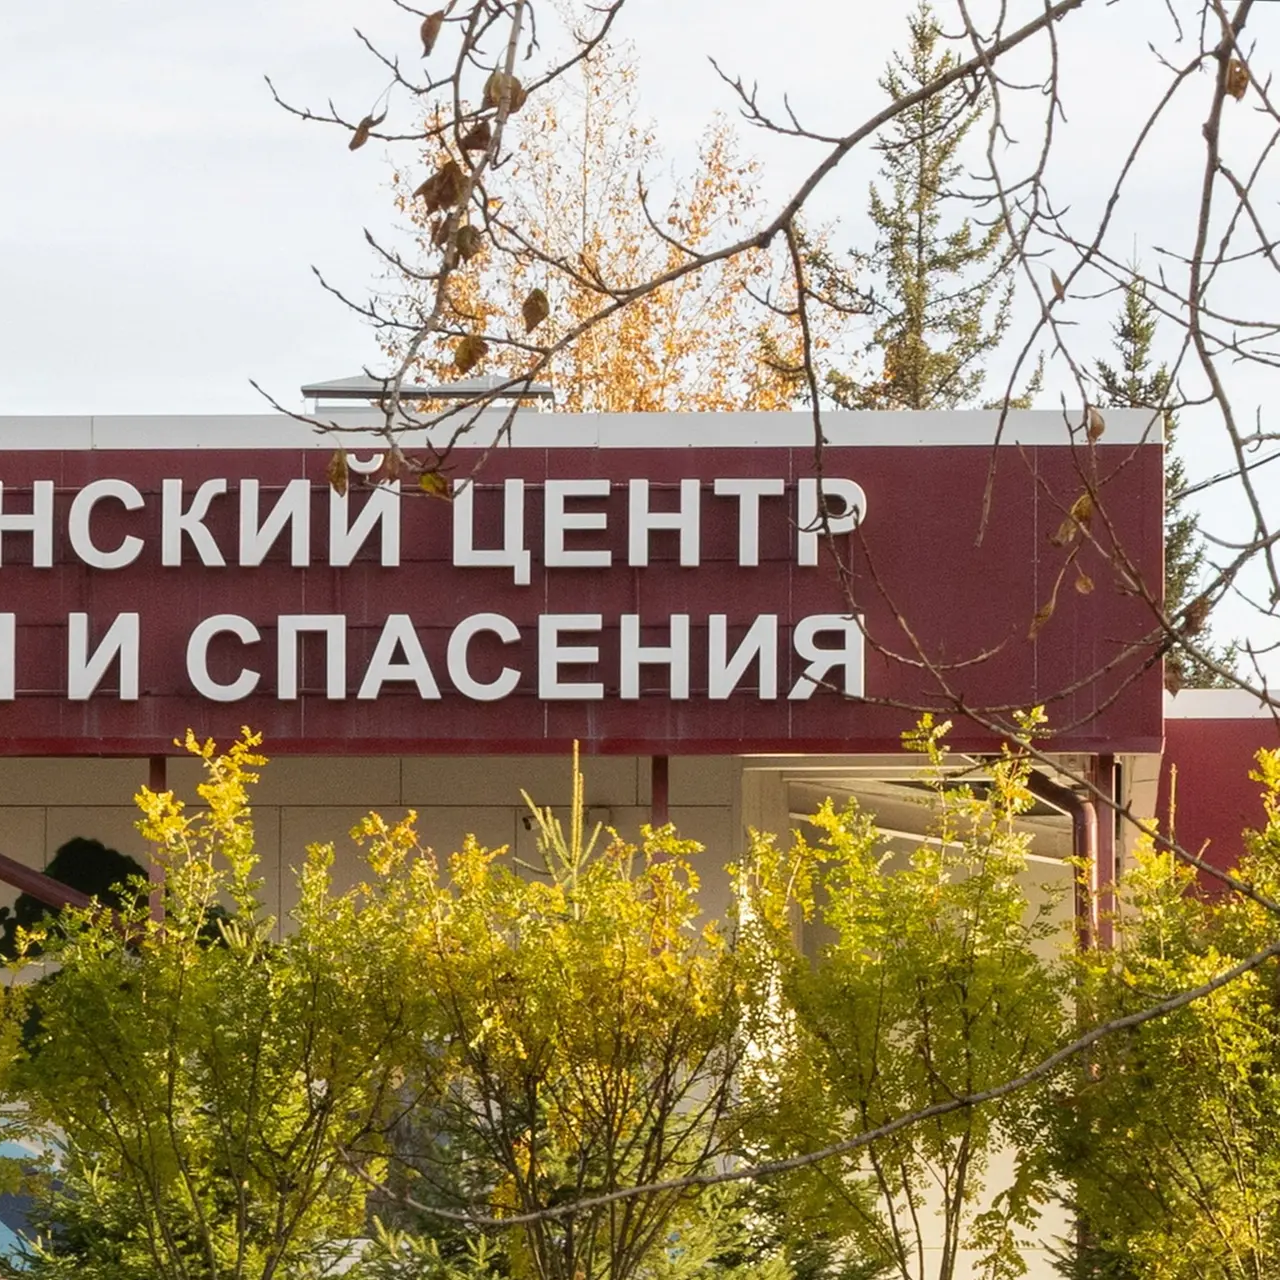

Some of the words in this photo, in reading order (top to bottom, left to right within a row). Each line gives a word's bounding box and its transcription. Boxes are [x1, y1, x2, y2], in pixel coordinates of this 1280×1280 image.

[452, 477, 867, 585] ЦЕНТР
[68, 612, 140, 700] И
[186, 612, 866, 702] СПАСЕНИЯ
